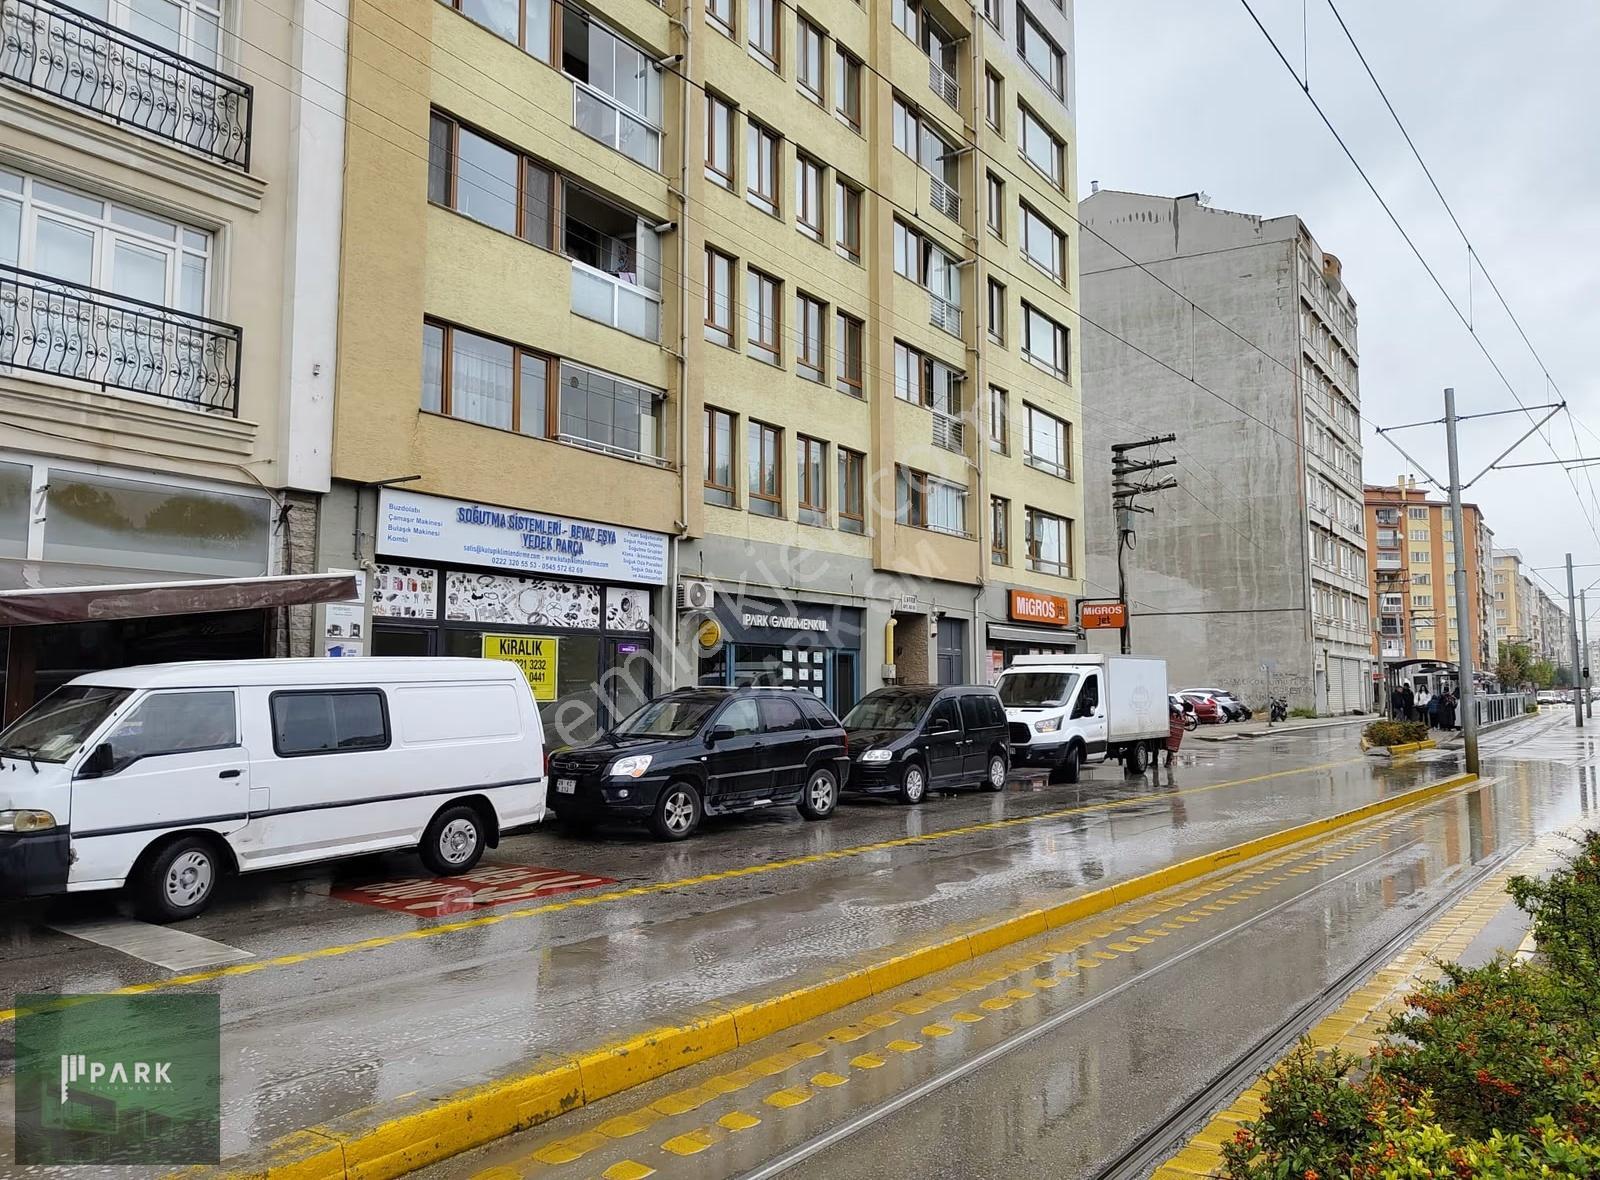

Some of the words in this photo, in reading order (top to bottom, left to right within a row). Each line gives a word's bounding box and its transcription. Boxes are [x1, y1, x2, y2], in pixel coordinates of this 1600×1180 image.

[416, 517, 443, 527] Makinesi
[457, 505, 506, 528] SOĞUTMA
[507, 512, 562, 536] SİSTEMLERİ
[570, 524, 596, 542] BEYAZ
[597, 528, 617, 546] EŞYA
[413, 527, 440, 536] Makinesi
[387, 534, 409, 543] Kombi
[521, 533, 553, 551] YEDEK
[556, 538, 584, 557] PARÇA
[491, 557, 507, 565] 0222
[745, 613, 769, 627] PARK
[1097, 614, 1111, 626] jet
[529, 659, 547, 670] 3232
[528, 671, 545, 683] 0441
